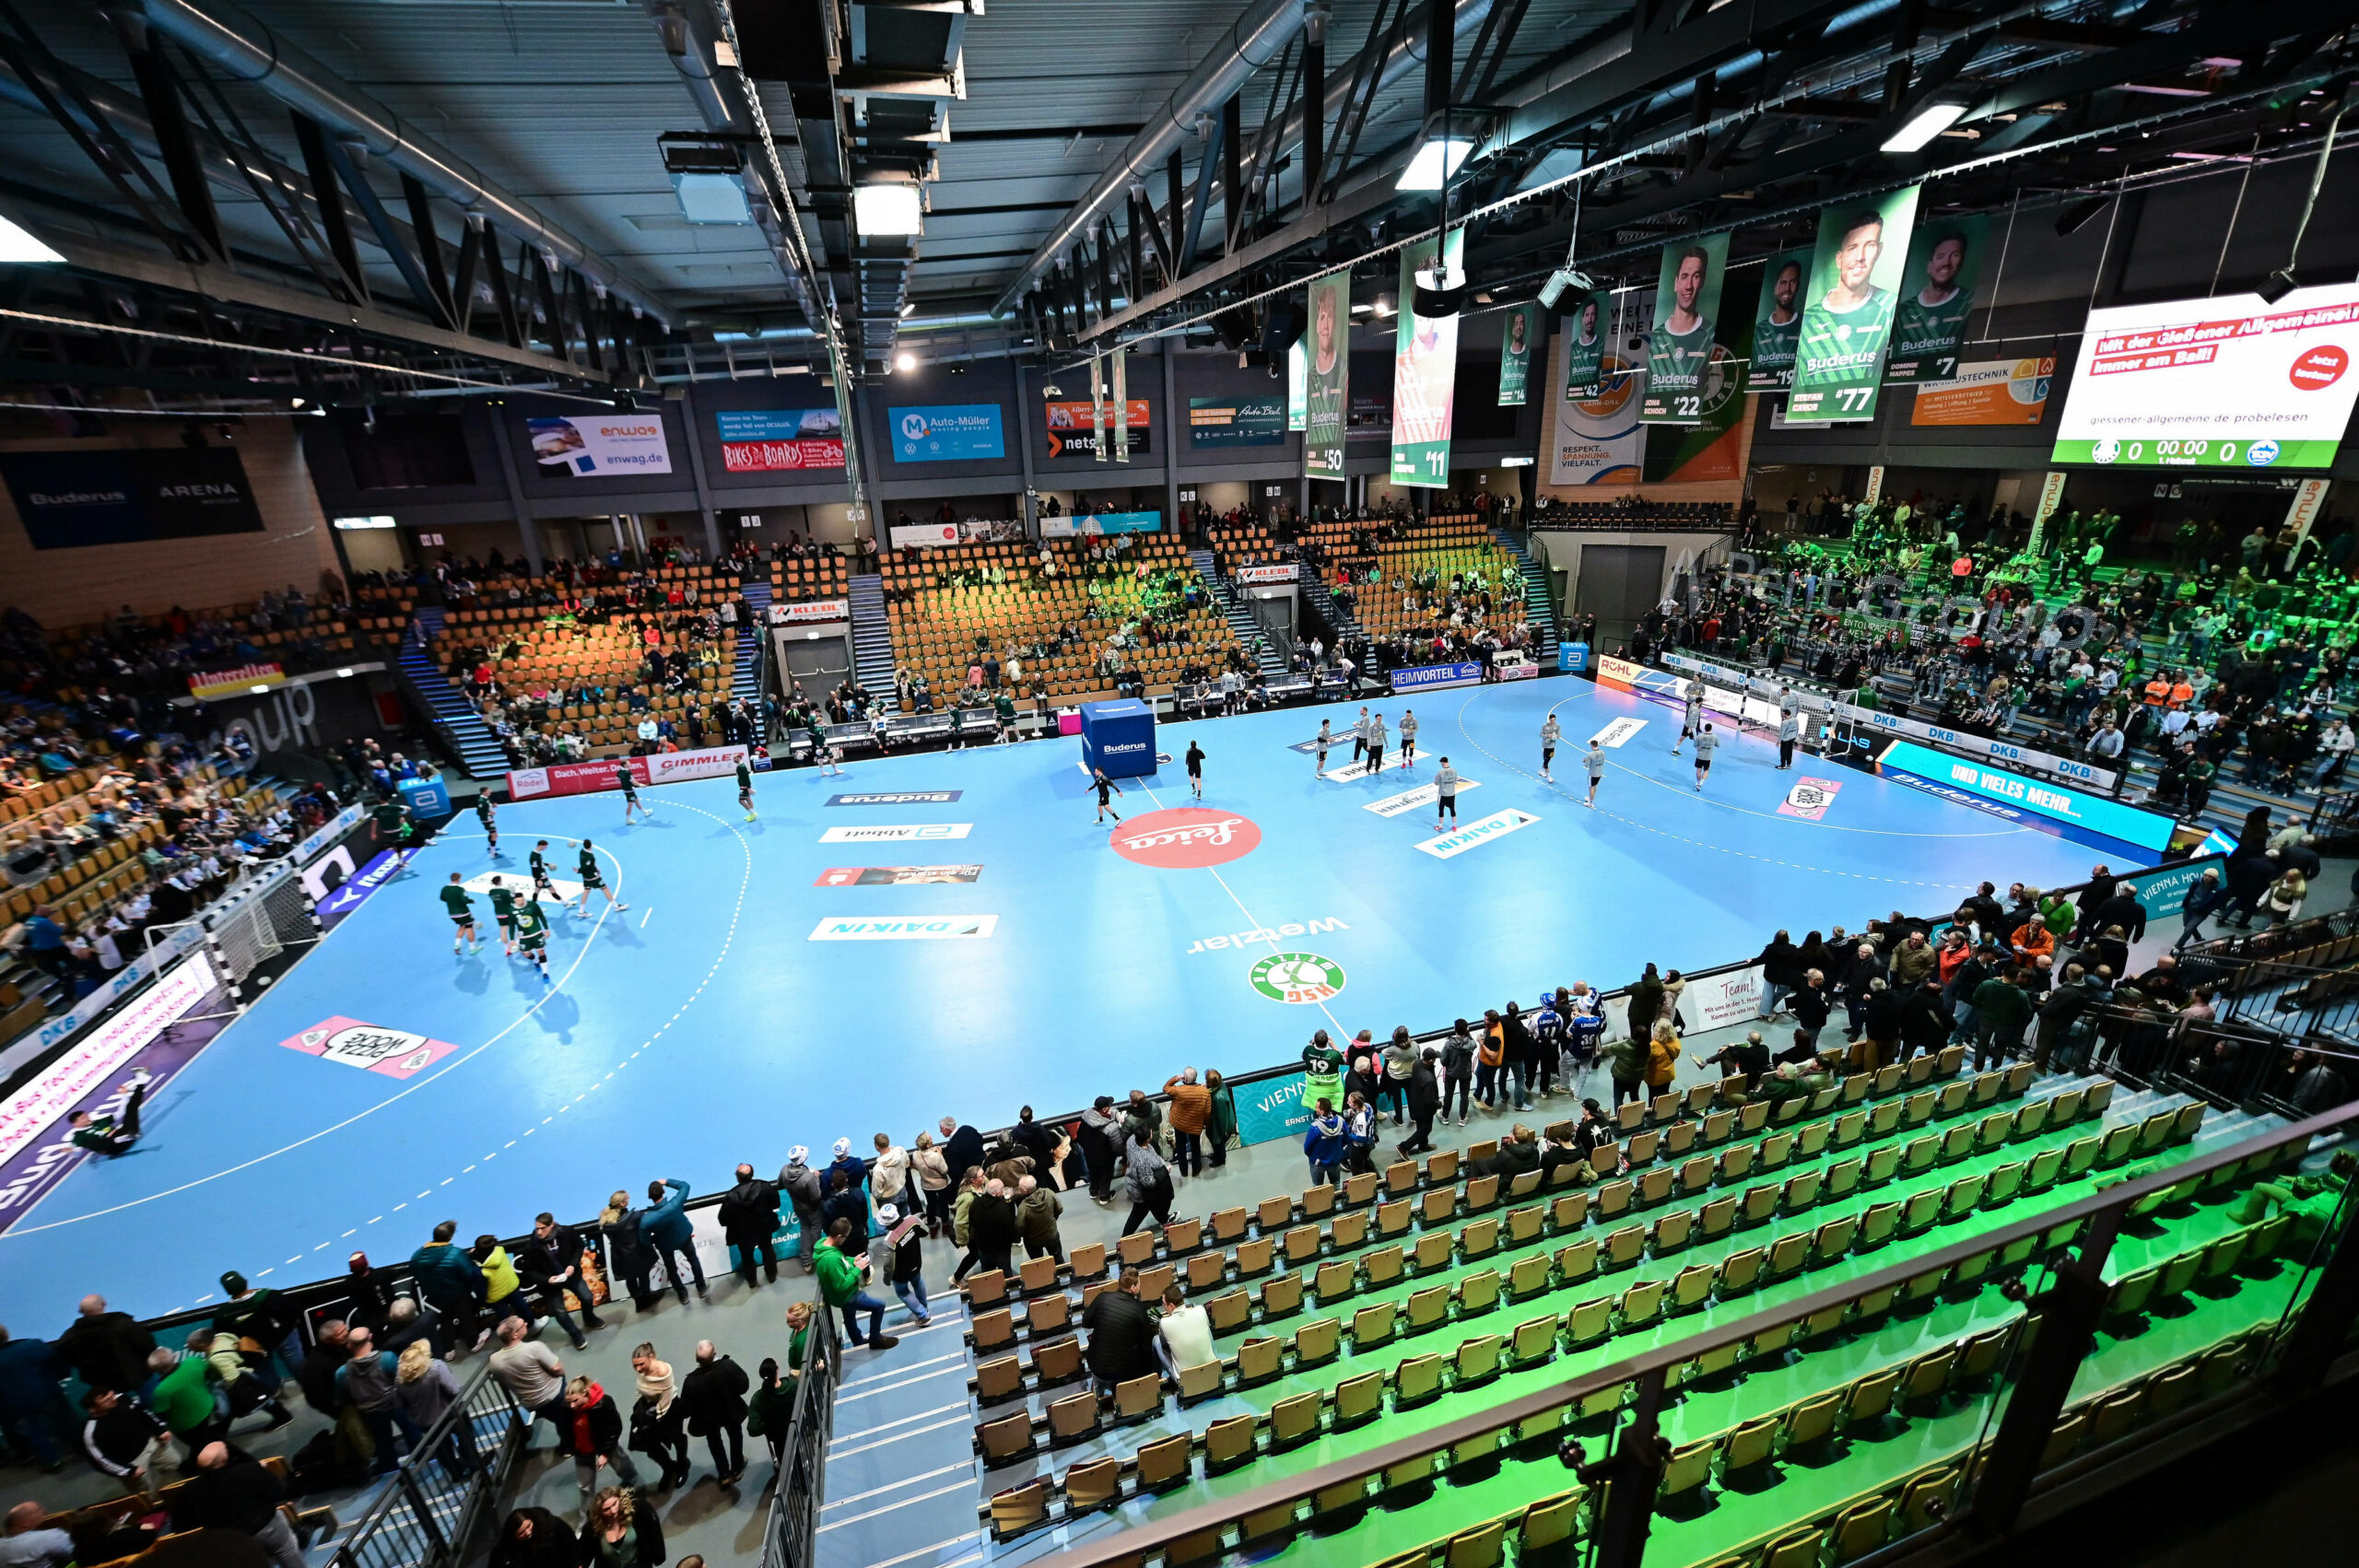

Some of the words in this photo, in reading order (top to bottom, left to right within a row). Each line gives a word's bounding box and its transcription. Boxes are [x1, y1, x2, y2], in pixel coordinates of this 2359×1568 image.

[1901, 335, 1956, 351] Buderus
[2098, 338, 2123, 354] Mit
[2127, 335, 2154, 350] der
[1758, 353, 1796, 362] Buderus
[1807, 351, 1876, 373] Buderus
[2094, 355, 2143, 374] Immer
[2145, 353, 2171, 368] am
[2174, 346, 2213, 365] Ball!
[2306, 354, 2339, 368] Jetzt
[1572, 366, 1597, 374] Buderus
[1890, 361, 1919, 370] DOMINIK
[1936, 357, 1955, 376] #7
[1651, 372, 1698, 386] Buderus
[1889, 369, 1916, 378] MAPPES
[1793, 393, 1824, 402] STEFAN
[1835, 387, 1874, 412] #77
[1673, 396, 1700, 415] #22
[930, 416, 991, 427] Auto-Müller
[1311, 411, 1340, 424] Buderus
[601, 426, 657, 437] enwag
[1562, 445, 1602, 454] RESPEKT.
[2128, 442, 2142, 461] 0
[2156, 439, 2209, 456] 00:00
[2219, 442, 2236, 462] 0
[606, 453, 663, 465] enwag.de
[723, 444, 753, 468] BIKES
[763, 443, 803, 466] BOARDS
[1562, 451, 1612, 461] SPANNUNG.
[159, 484, 238, 497] ARENA
[29, 490, 126, 506] Buderus
[1255, 568, 1292, 576] KLEBL
[793, 603, 840, 615] KLEBL
[1844, 618, 1889, 635] ENTOURAGE
[1666, 655, 1681, 665] DKB
[1701, 663, 1717, 674] DKB
[1392, 667, 1457, 685] HEIMVORTEIL
[1739, 673, 1755, 687] DB
[1873, 714, 1897, 728] DKB
[1929, 728, 1954, 742] DKB
[1104, 742, 1146, 753] Buderus
[1989, 743, 2018, 759] DKB
[554, 768, 578, 779] Dach.
[578, 766, 610, 777] Weiter.
[2059, 760, 2091, 778] DKB
[516, 778, 545, 789] Rödel
[1951, 763, 1978, 785] UND
[1982, 772, 2026, 800] VIELES
[2026, 786, 2082, 818] MEHR...
[839, 793, 951, 803] Buderus
[1798, 787, 1811, 804] WOLKE
[1812, 790, 1824, 805] PIZZA
[1892, 773, 2022, 818] Buderus
[844, 829, 910, 837] Abbott
[1121, 818, 1243, 851] Leica
[1435, 819, 1507, 852] DAIKIN
[2142, 875, 2179, 901] VIENNA
[2159, 903, 2174, 911] ERNST
[828, 922, 952, 934] DAIKIN
[1251, 953, 1336, 983] WETZLAR
[113, 967, 139, 994] DKB
[1287, 982, 1335, 1002] HSG
[1720, 976, 1754, 1000] Team!
[1746, 994, 1762, 1003] Hotel
[1710, 1012, 1730, 1022] Komm
[40, 1015, 76, 1047] DKB
[344, 1032, 407, 1049] WOLKE
[337, 1042, 390, 1059] PIZZA
[1309, 1059, 1330, 1072] 19
[1256, 1079, 1309, 1113] VIENN
[1285, 1116, 1309, 1127] ERNST
